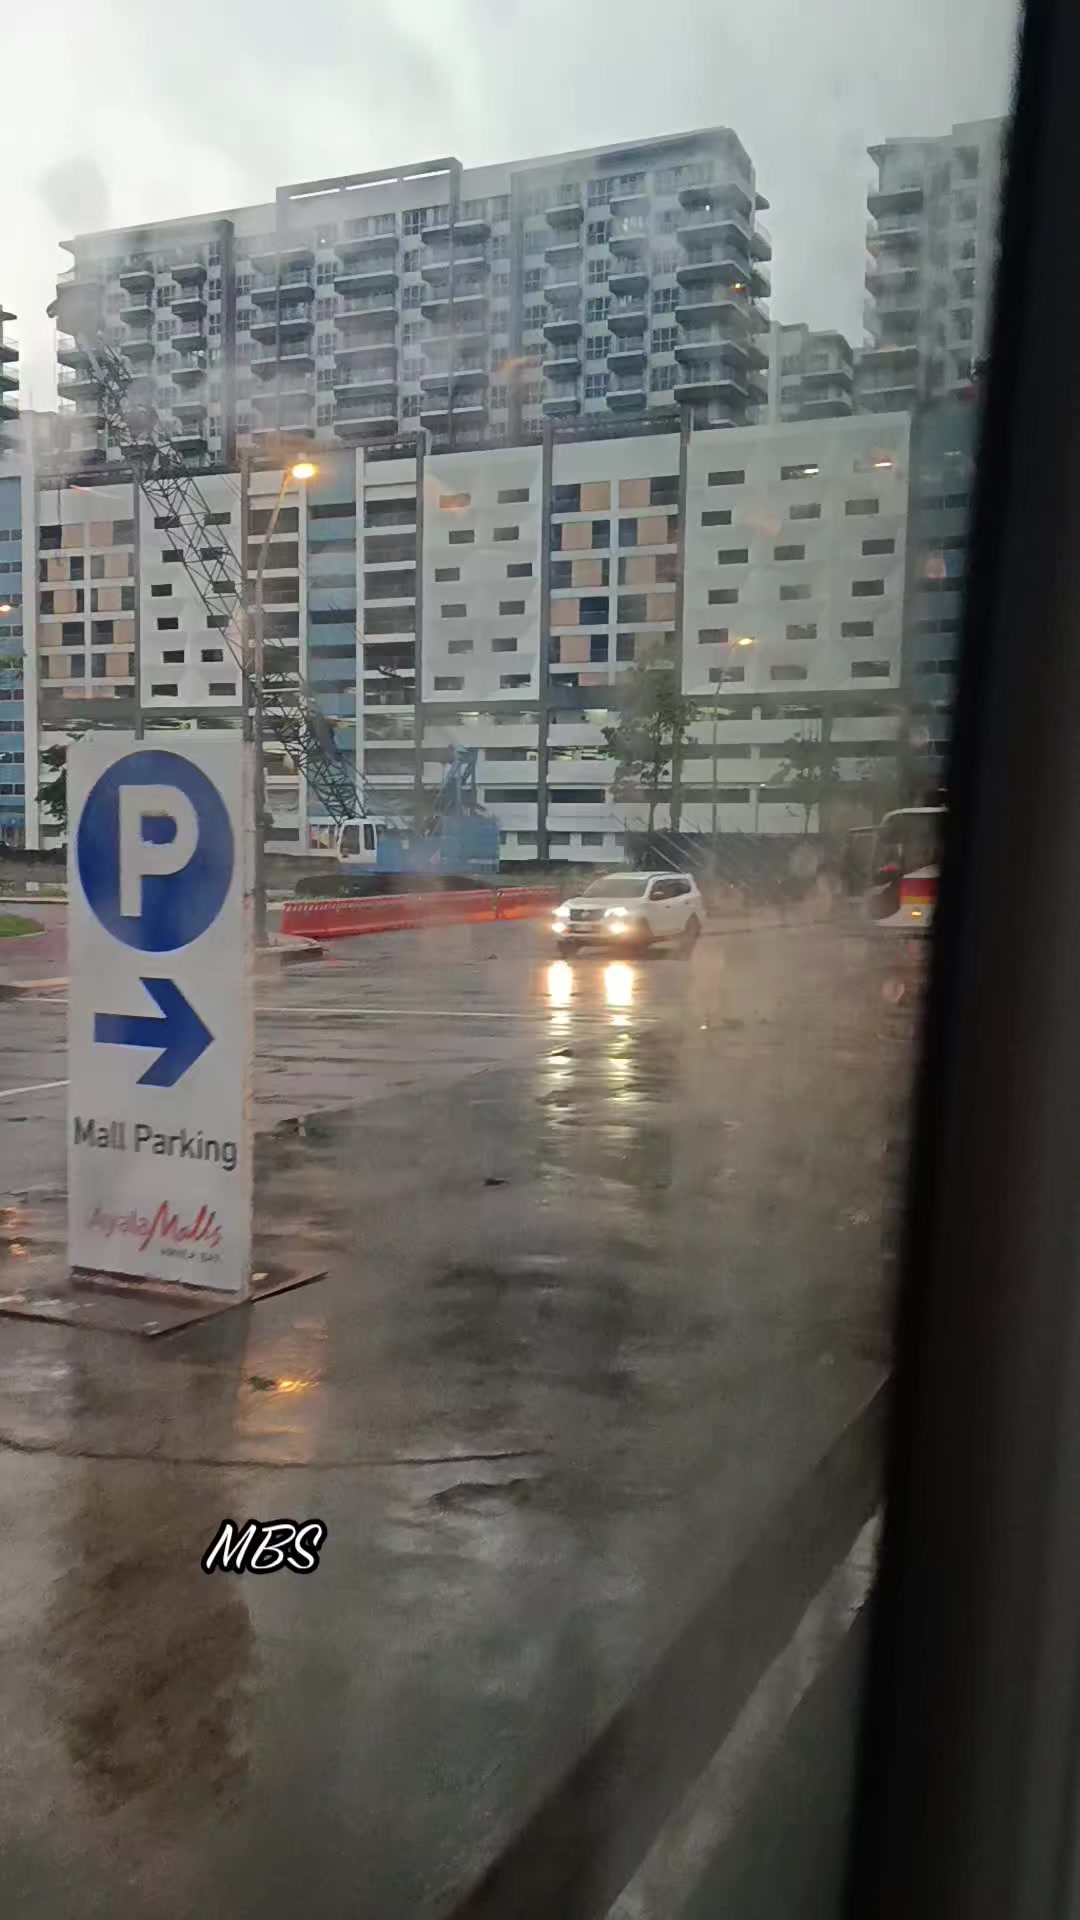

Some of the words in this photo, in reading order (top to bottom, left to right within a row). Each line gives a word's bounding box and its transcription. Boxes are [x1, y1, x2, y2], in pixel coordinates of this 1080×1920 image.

[119, 784, 199, 917] P
[74, 1116, 126, 1150] Mall
[134, 1123, 238, 1171] Parking
